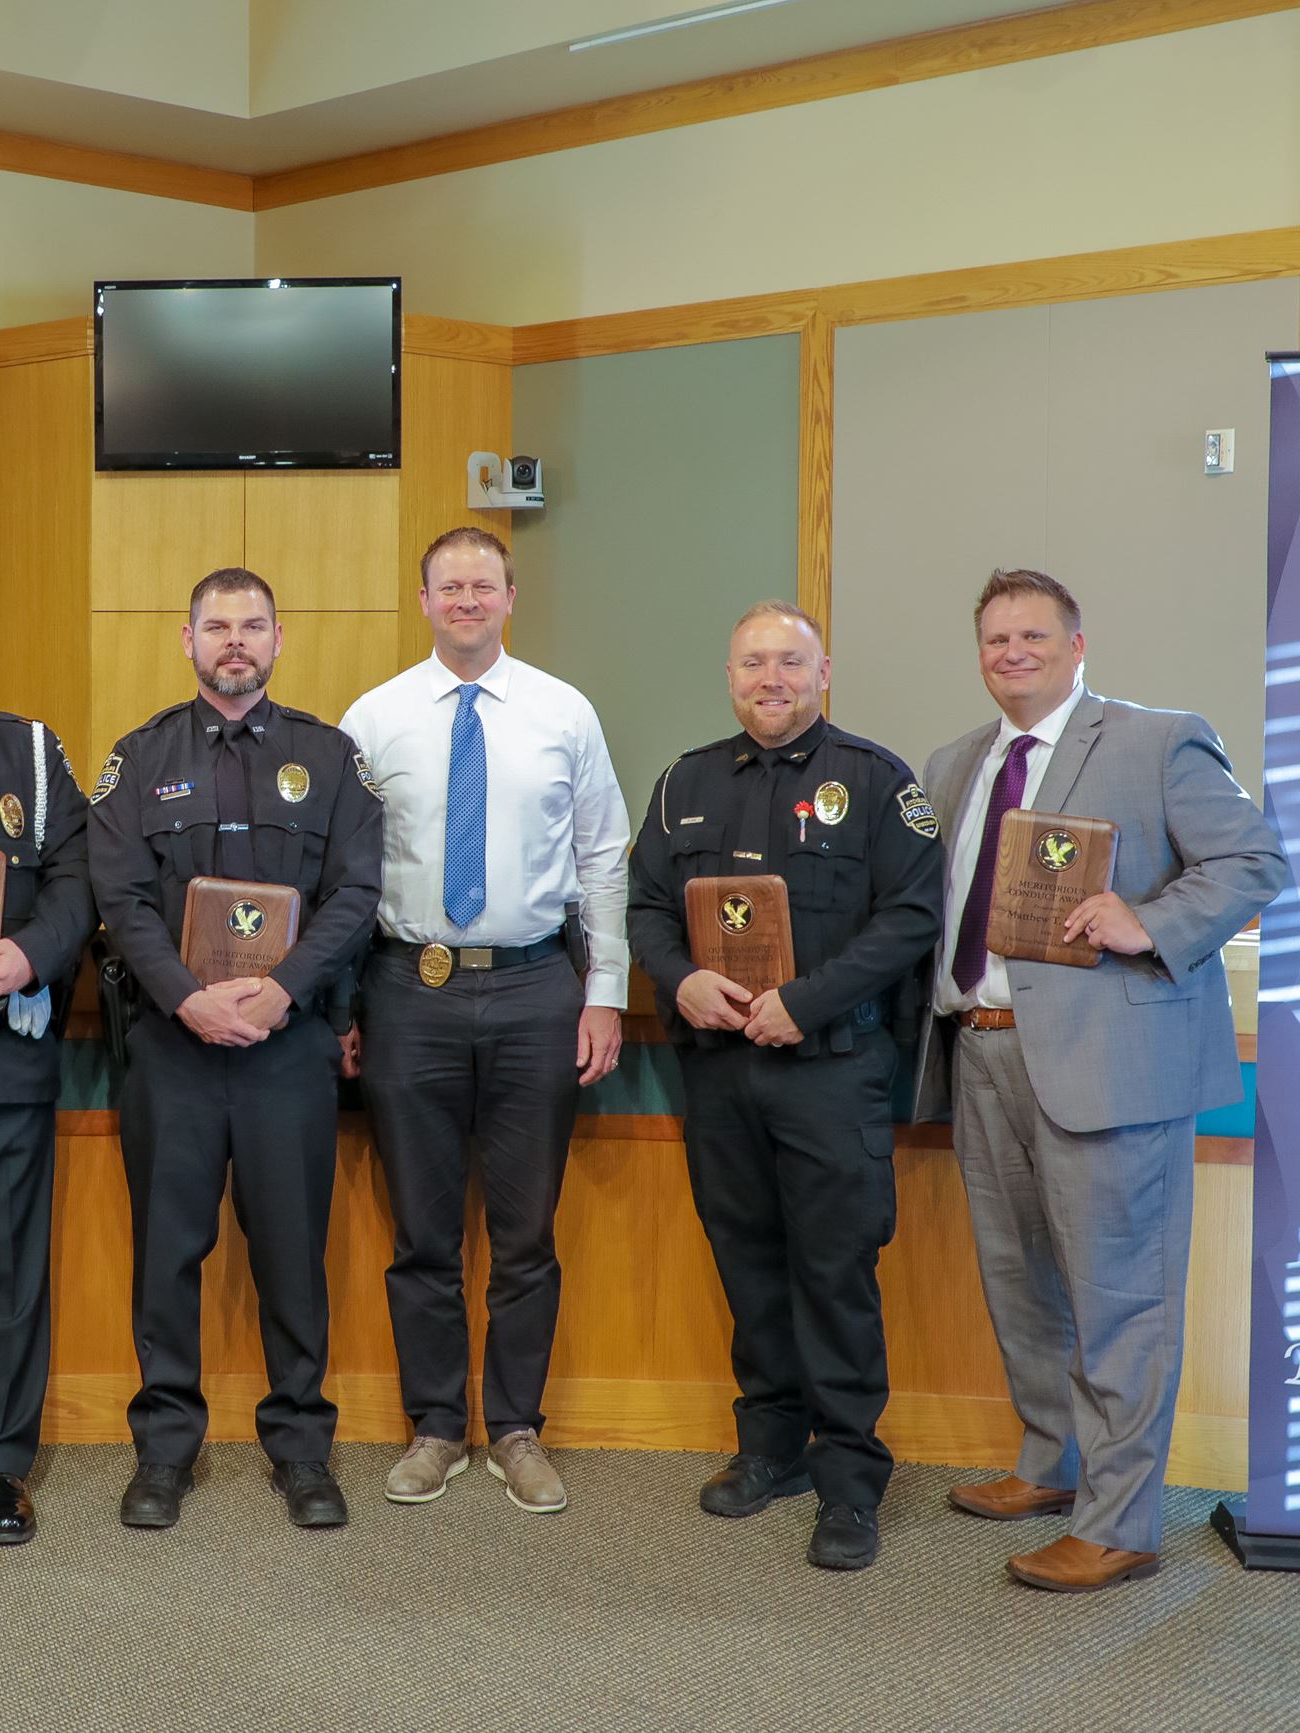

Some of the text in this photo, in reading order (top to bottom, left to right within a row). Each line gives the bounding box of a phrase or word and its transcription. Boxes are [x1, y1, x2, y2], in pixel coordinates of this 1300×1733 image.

[1008, 887, 1057, 900] CONDUCT
[1018, 880, 1087, 895] MERITORIOUS
[1007, 910, 1050, 923] Matthew
